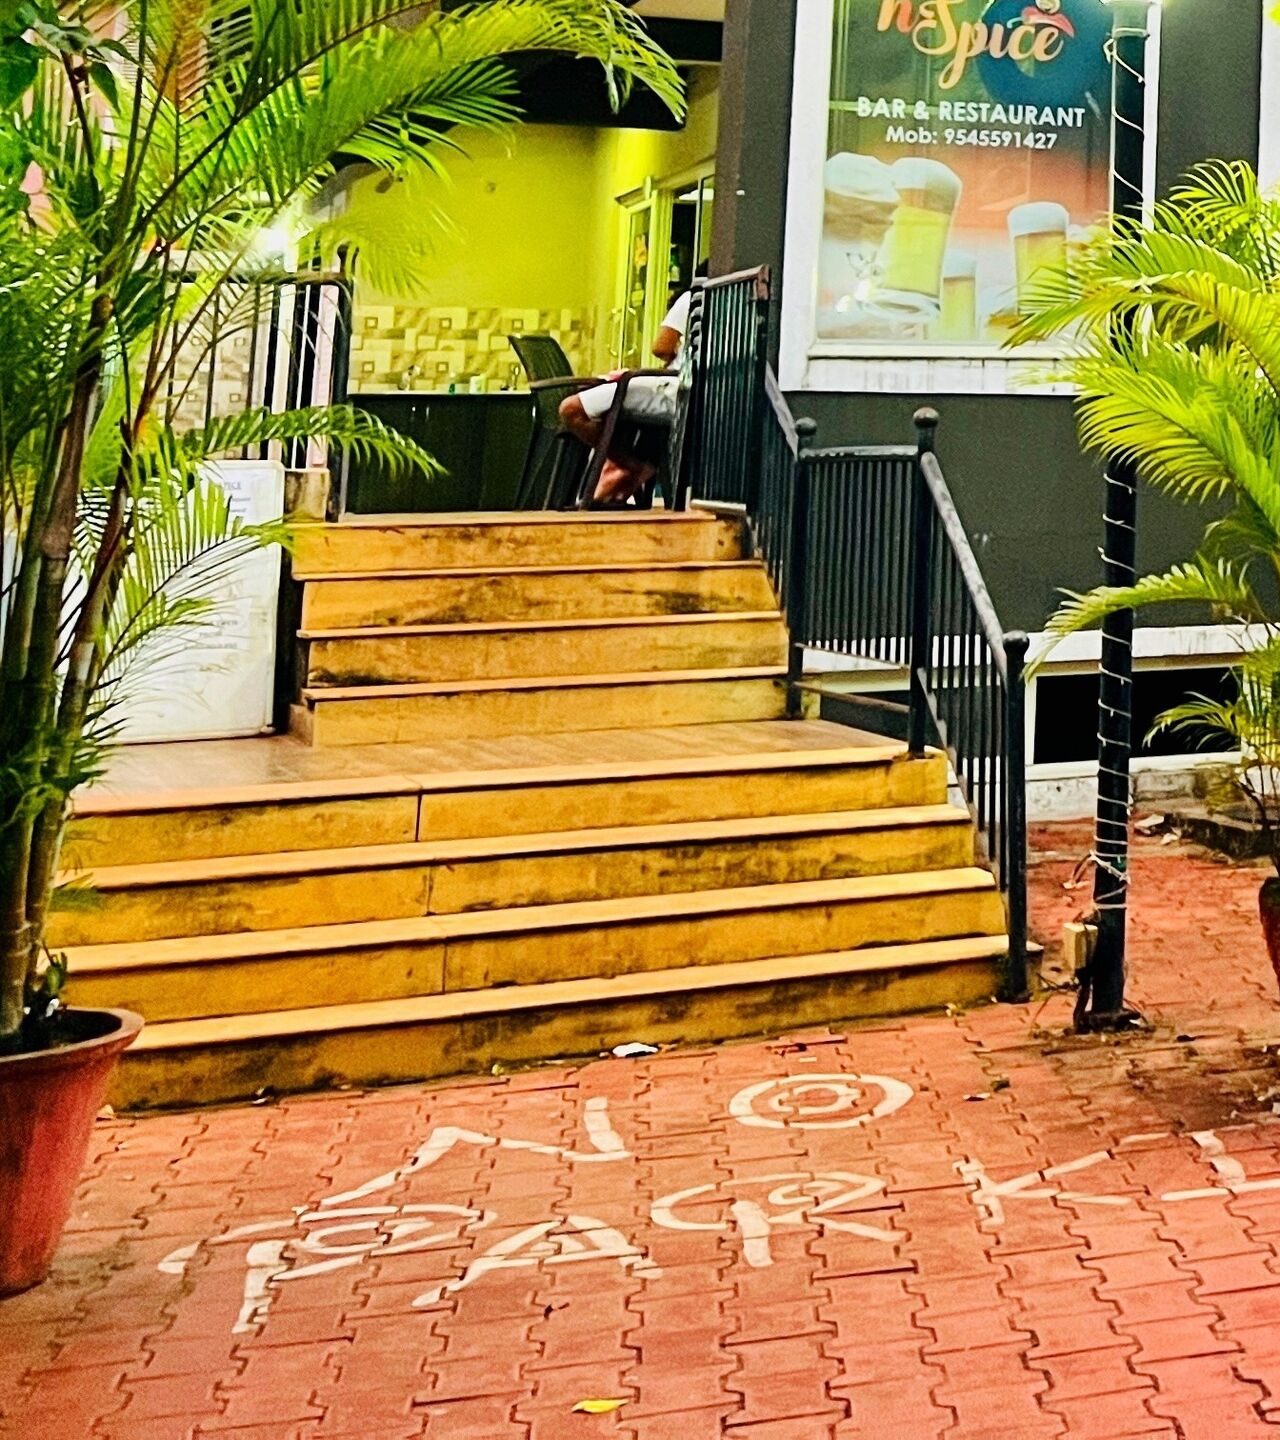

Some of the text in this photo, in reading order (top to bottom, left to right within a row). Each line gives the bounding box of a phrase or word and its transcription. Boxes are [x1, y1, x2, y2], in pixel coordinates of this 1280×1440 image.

[857, 96, 1085, 128] BAR & RESTAURANT
[886, 126, 1058, 149] Mob: 9545591427
